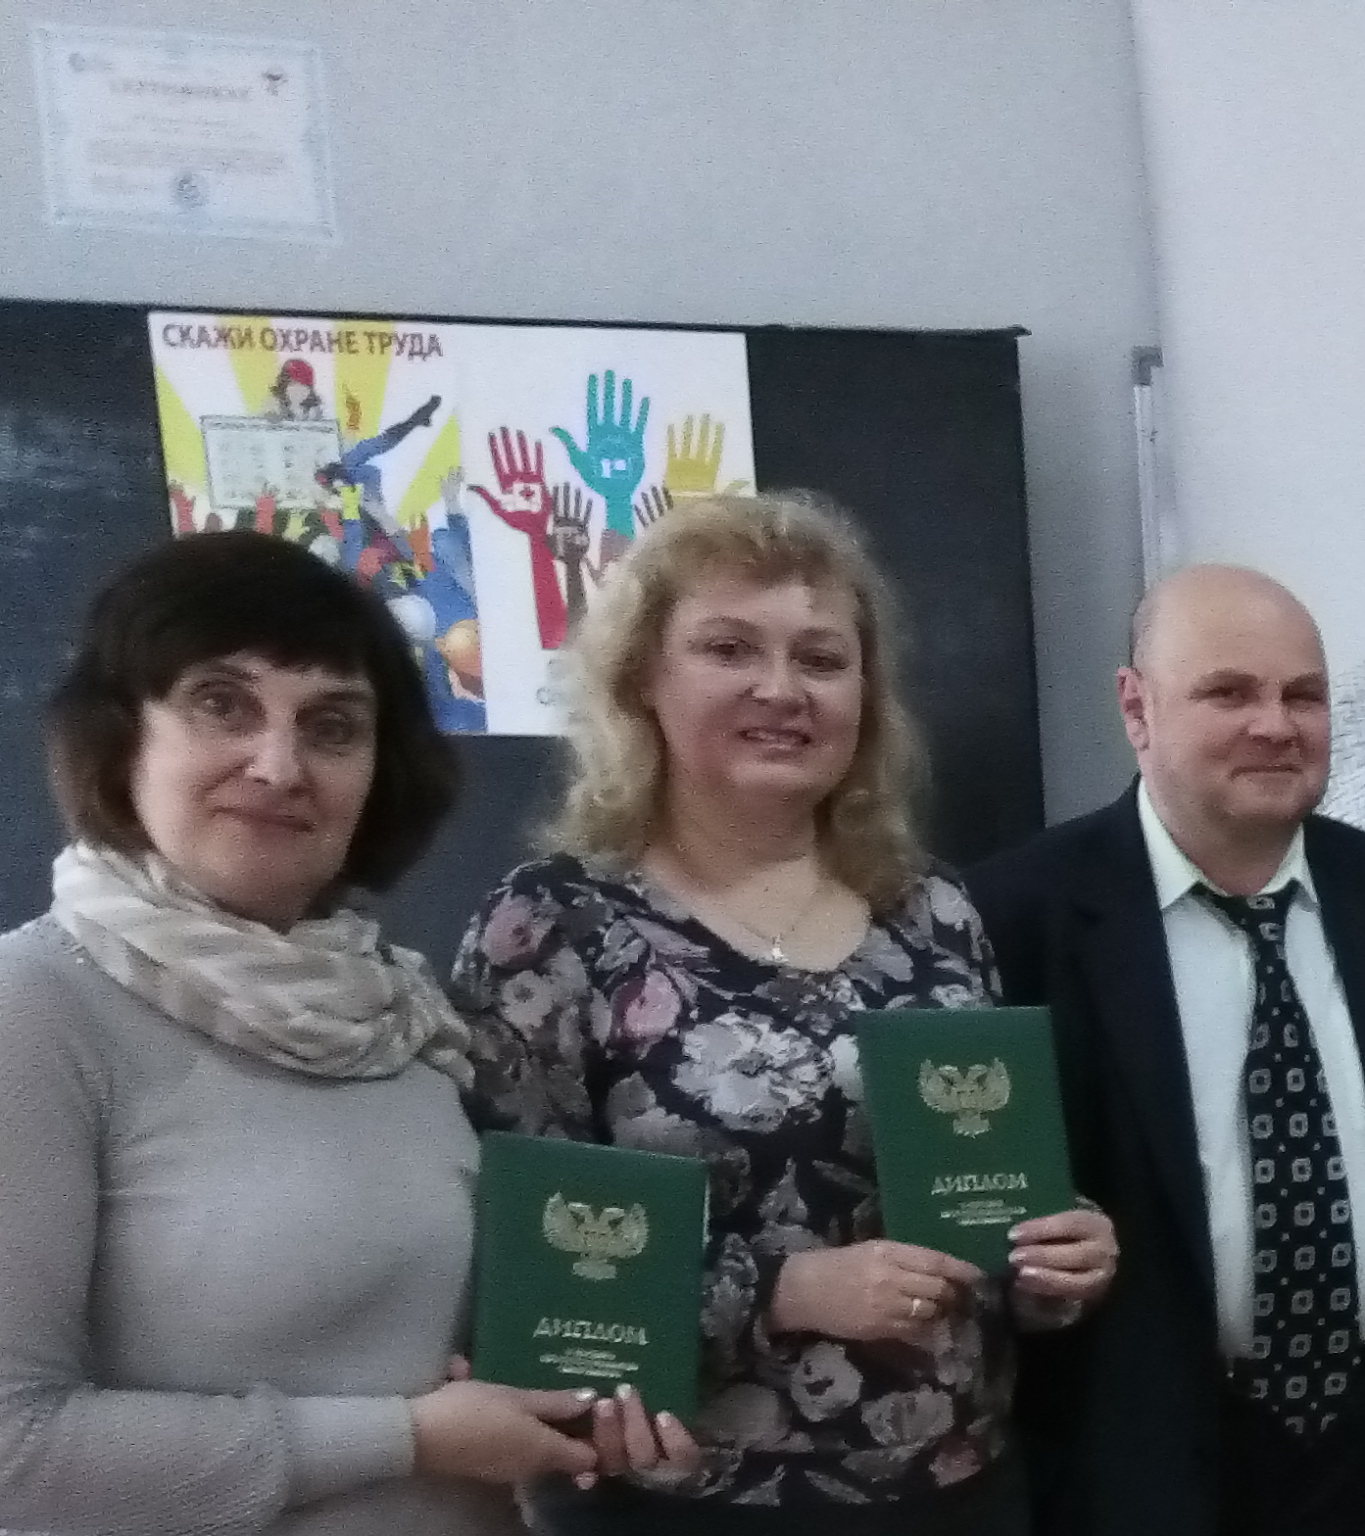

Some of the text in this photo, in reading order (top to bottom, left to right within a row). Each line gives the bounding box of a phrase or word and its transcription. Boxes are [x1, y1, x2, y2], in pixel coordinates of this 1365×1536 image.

[162, 323, 444, 361] СКАЖИ ОХРАНЕ ТРУДА
[931, 1172, 1029, 1195] ДИПЛОМ
